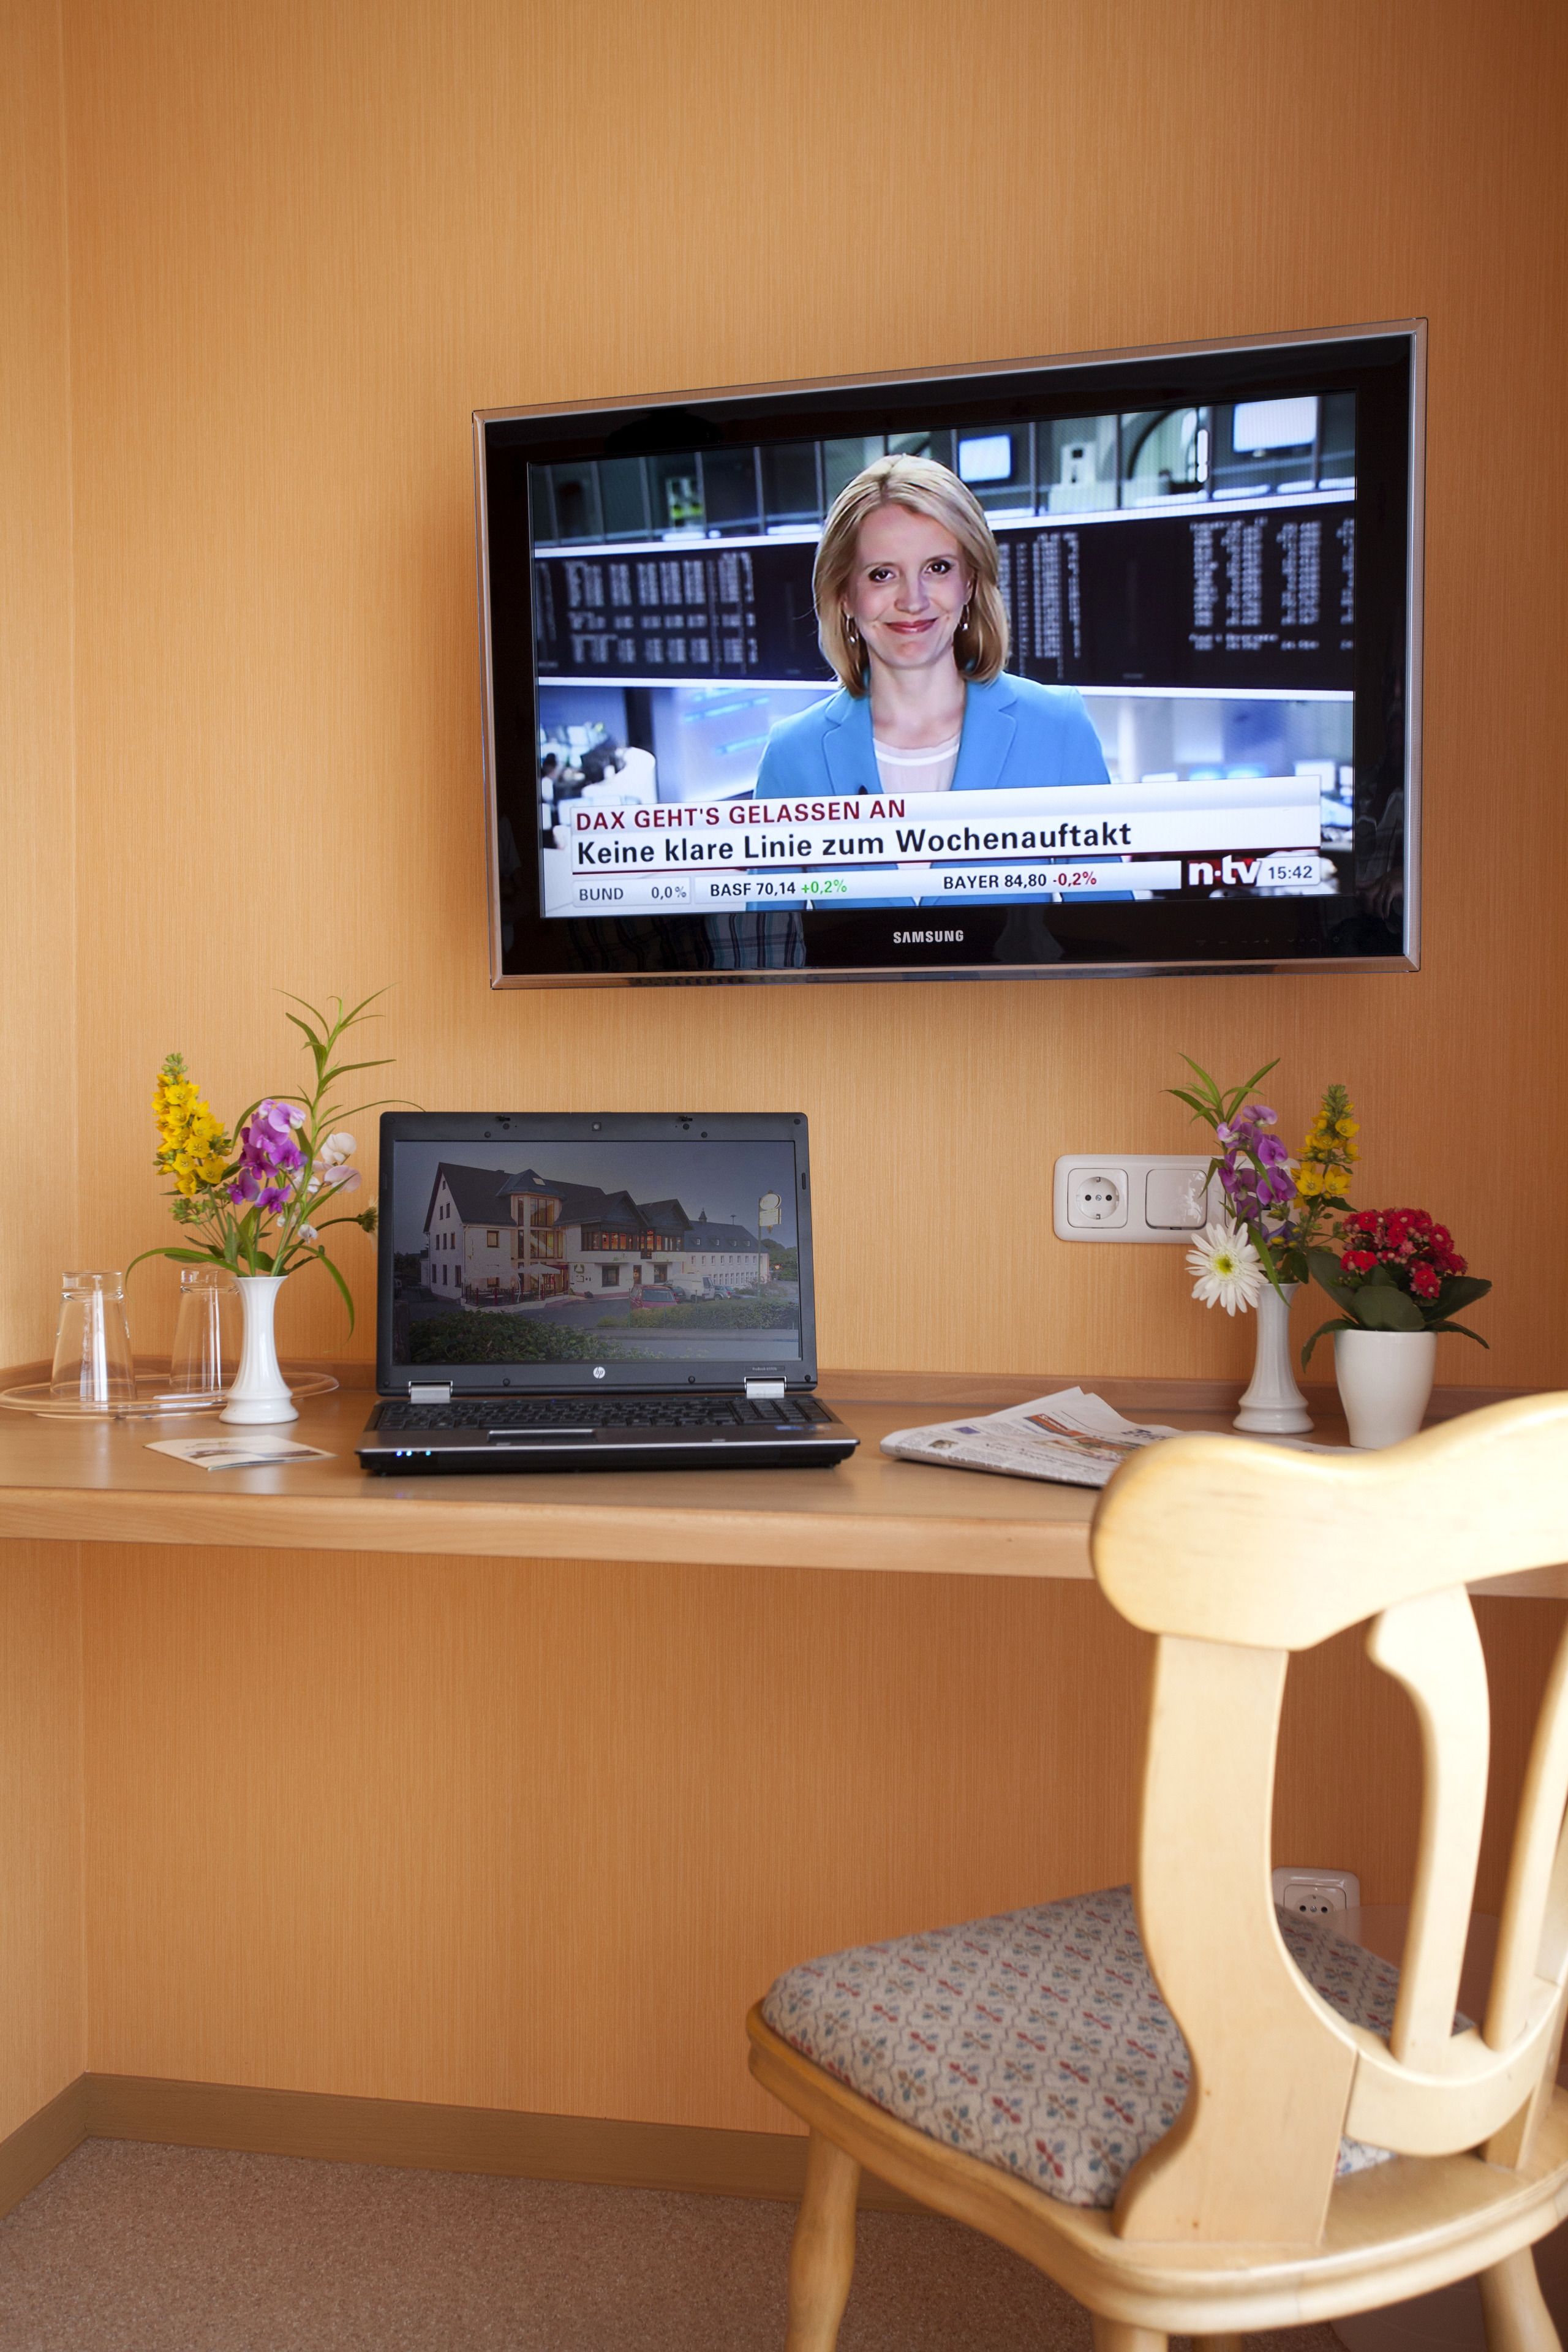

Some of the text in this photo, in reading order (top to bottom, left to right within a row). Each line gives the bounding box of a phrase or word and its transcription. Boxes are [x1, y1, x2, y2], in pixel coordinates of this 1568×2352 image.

[576, 799, 906, 831] DAX GEHT'S GELASSEN AN
[578, 822, 1132, 865] Keine klare Linie zum Wochenauftakt
[943, 871, 1097, 889] BAYER 84,80 -0,2%
[1268, 865, 1313, 880] 15:42
[579, 888, 624, 901] BUND
[651, 886, 687, 900] 0,0%
[710, 880, 848, 897] BASF 70,14 +0,2%
[893, 930, 964, 944] SAMSUNG
